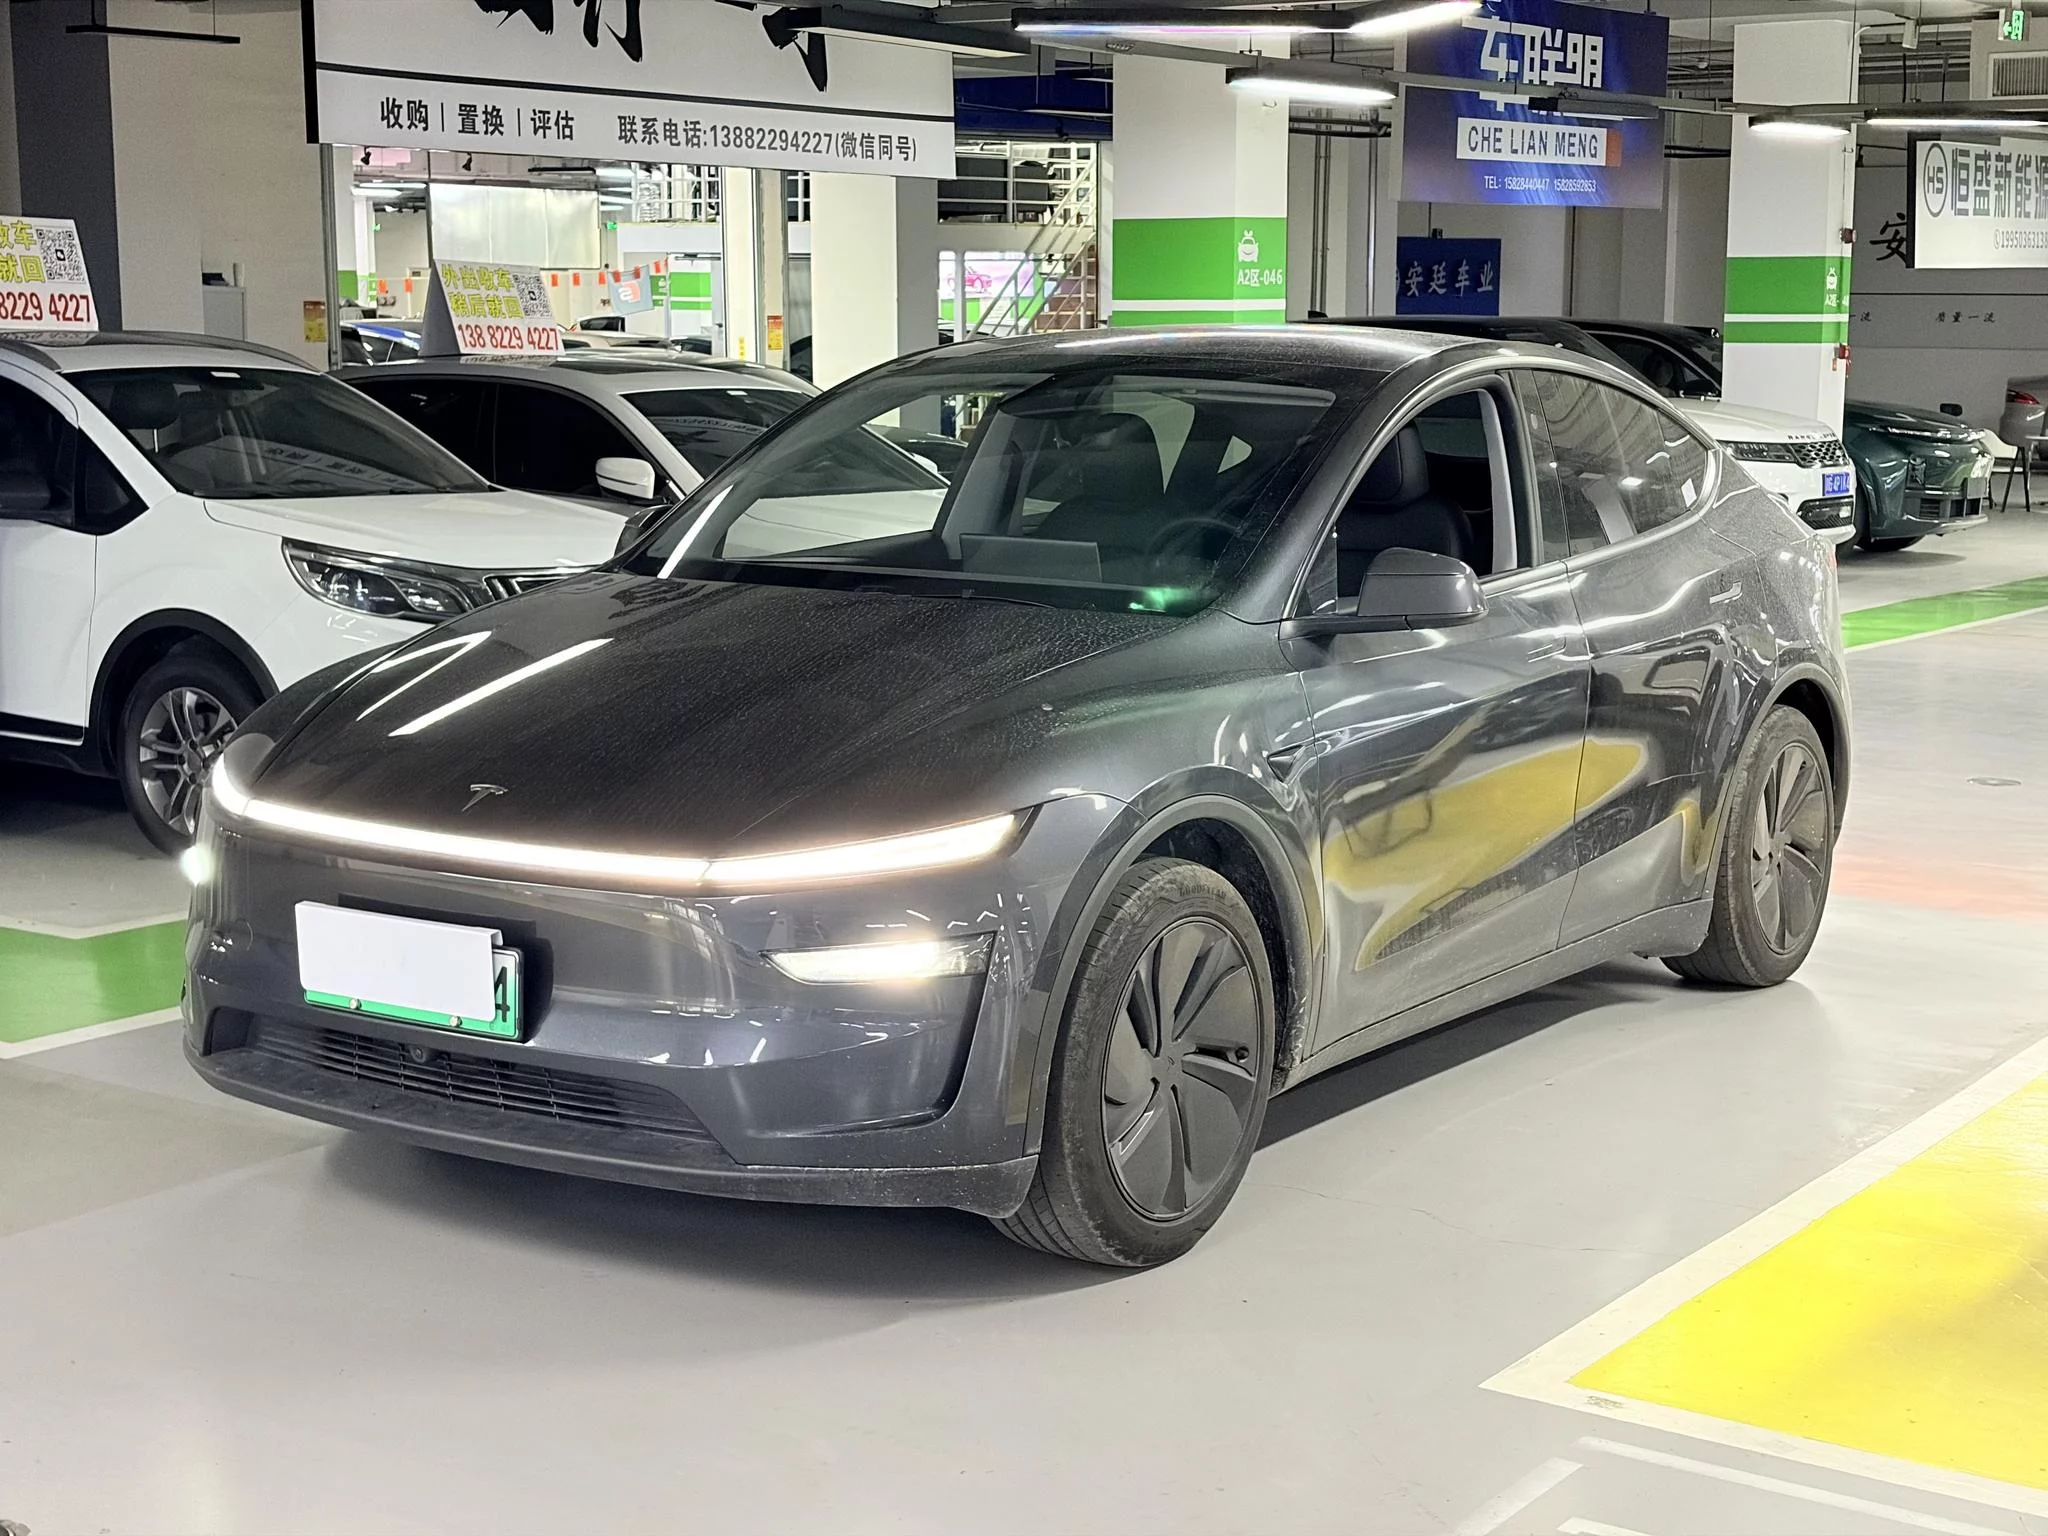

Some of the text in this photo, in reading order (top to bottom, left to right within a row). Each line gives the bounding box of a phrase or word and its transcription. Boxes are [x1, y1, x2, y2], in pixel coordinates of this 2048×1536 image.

[380, 96, 917, 162] 收购 置换 评估 联系电话:13882294227(微信同号)
[1468, 125, 1598, 158] CHE LIAN MENG
[1484, 175, 1502, 189] TEL:
[1927, 165, 1944, 194] HS
[1236, 268, 1283, 287] A2区-046
[48, 292, 91, 323] 4227
[457, 323, 560, 351] 138 8229 4227
